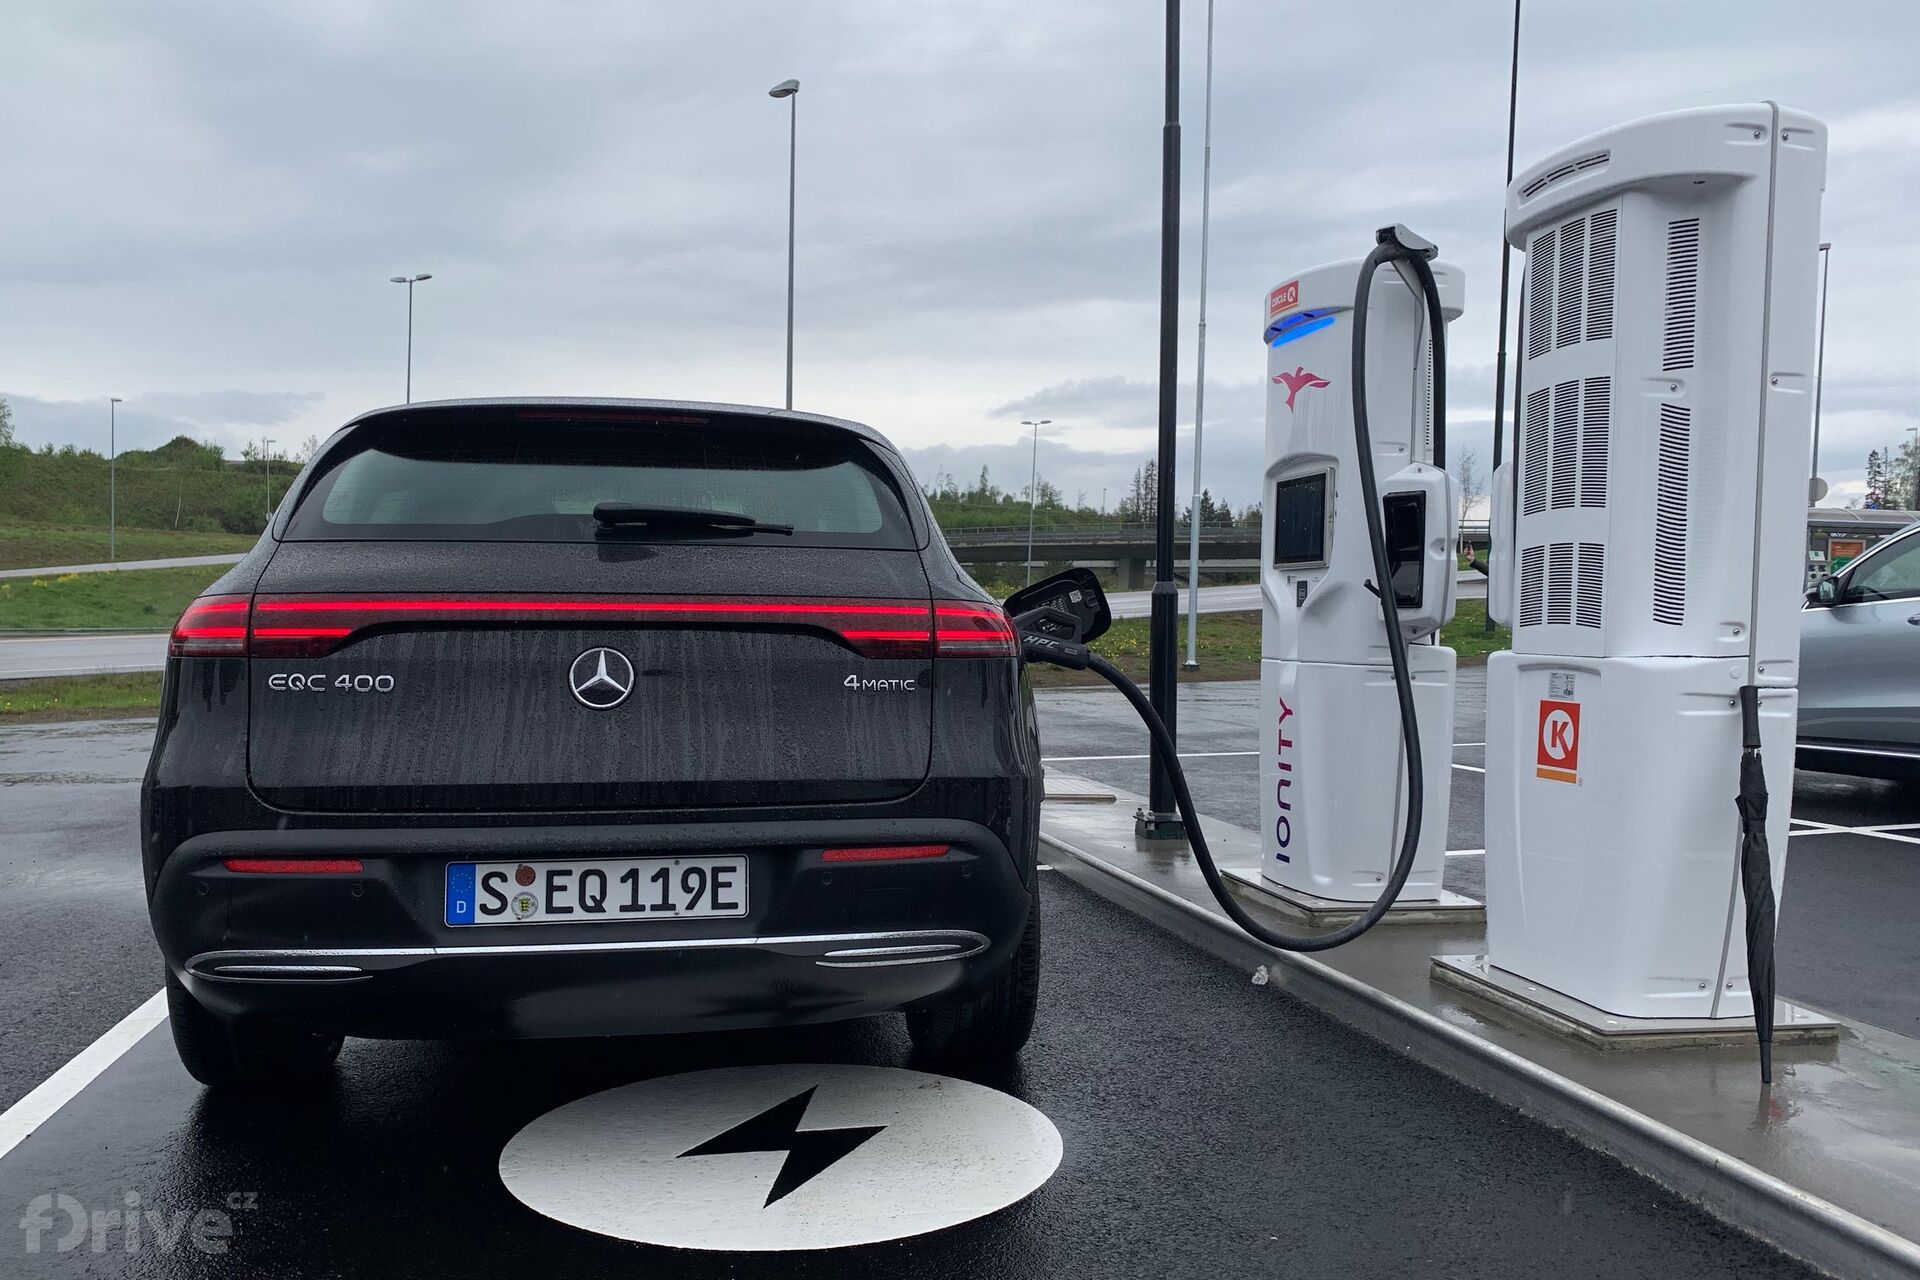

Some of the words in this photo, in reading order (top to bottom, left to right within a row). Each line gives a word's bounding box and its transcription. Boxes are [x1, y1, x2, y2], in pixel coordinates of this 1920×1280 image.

[1023, 635, 1060, 649] HPC
[268, 673, 327, 691] EQC
[334, 674, 395, 692] 400
[843, 674, 916, 691] 4MATIC
[1275, 697, 1294, 864] IONITY
[479, 871, 509, 916] S
[545, 869, 608, 915] EQ
[619, 866, 739, 912] 119E
[456, 900, 467, 914] D
